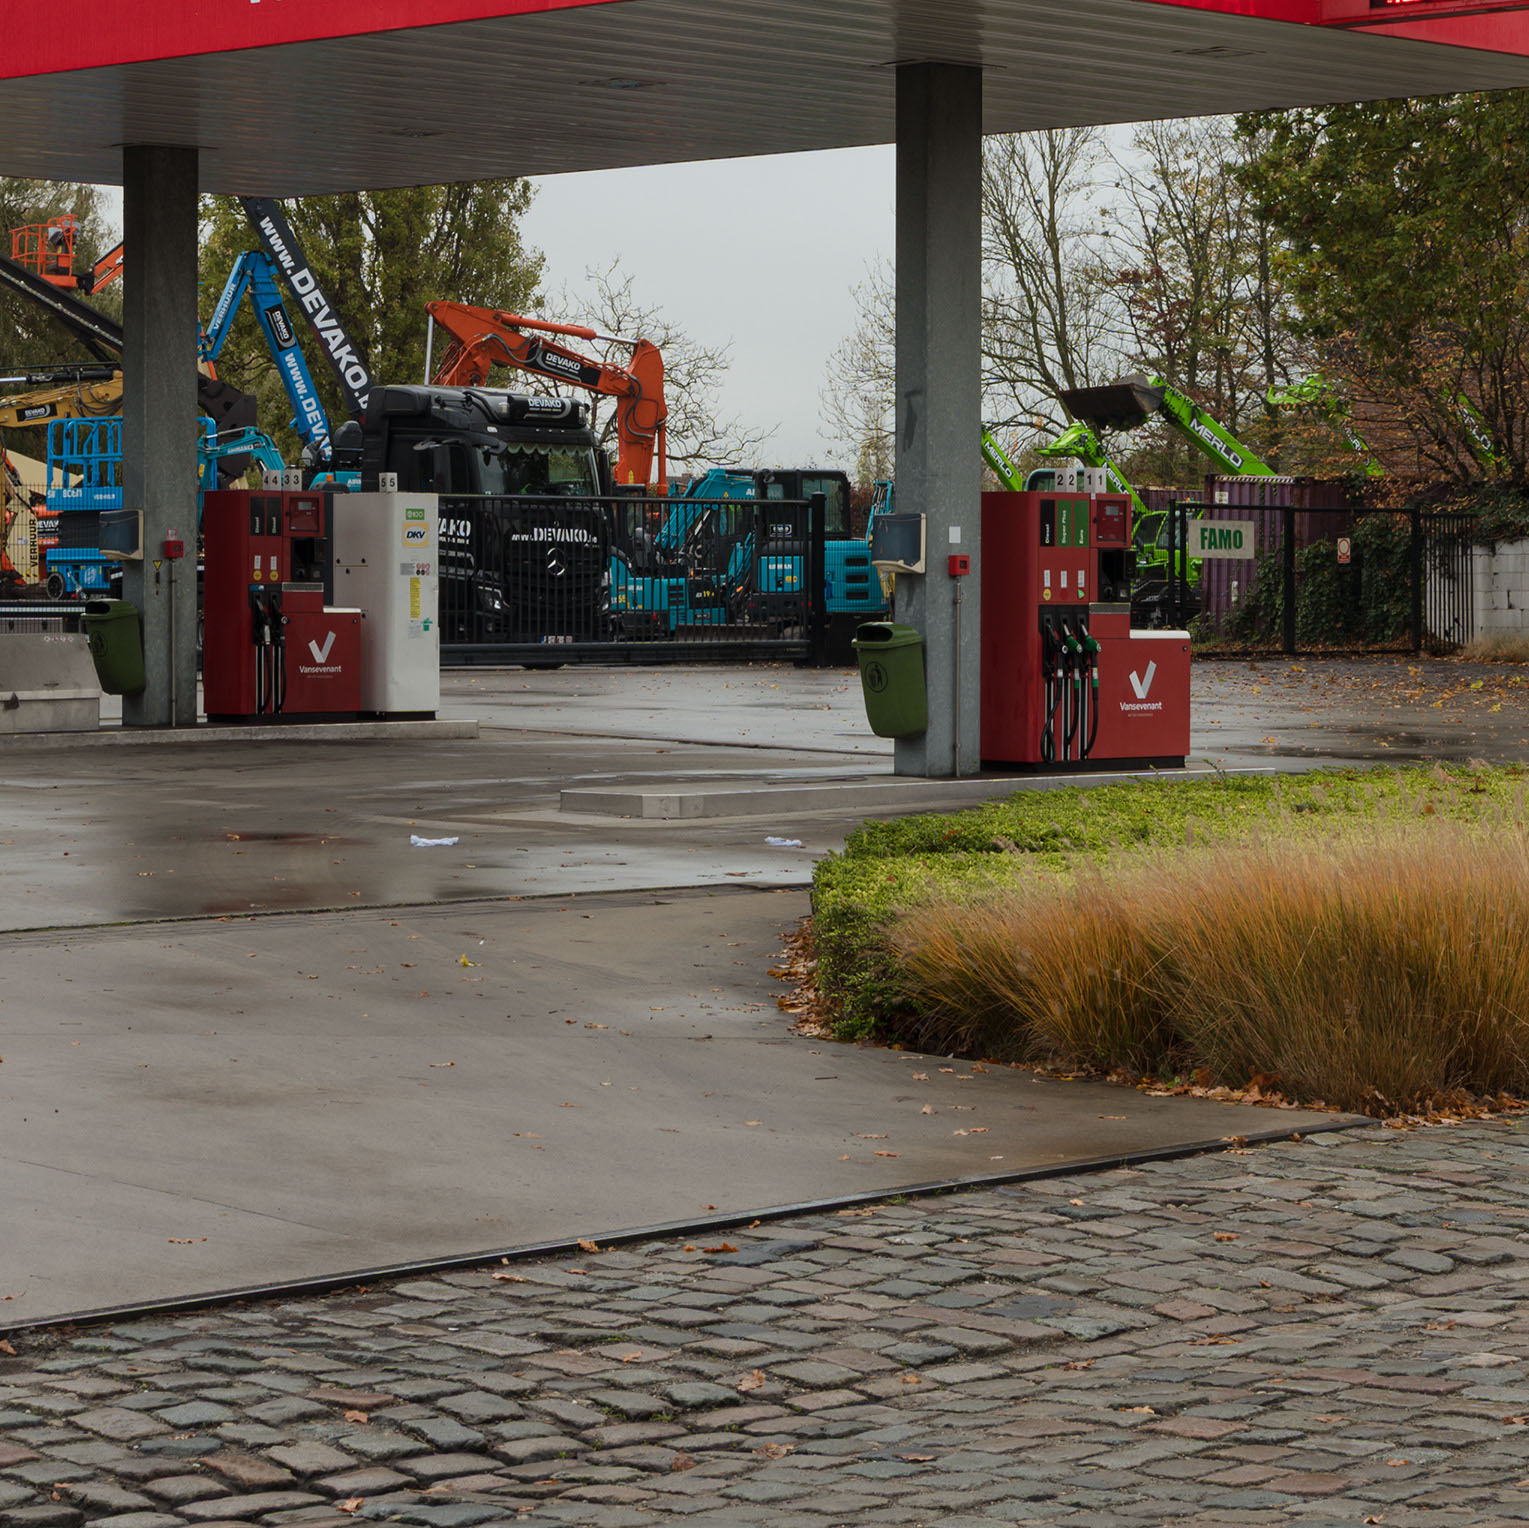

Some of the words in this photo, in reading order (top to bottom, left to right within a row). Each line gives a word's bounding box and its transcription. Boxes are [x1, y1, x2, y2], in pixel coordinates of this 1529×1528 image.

[213, 283, 238, 331] VERHUUR
[273, 310, 290, 340] DEVAKO
[545, 352, 581, 371] DEVAKO
[527, 398, 562, 408] DEVAKO
[1190, 417, 1244, 469] MERLO
[983, 440, 1014, 480] MERLO
[272, 475, 278, 484] 4
[293, 474, 300, 484] 3
[389, 477, 395, 487] 5
[1057, 474, 1064, 486] 2
[406, 530, 426, 540] DKV
[1200, 527, 1244, 550] FAMO
[29, 518, 39, 568] VERHUUR
[298, 665, 342, 673] Vansevenant
[1119, 701, 1163, 711] Vansevenant
